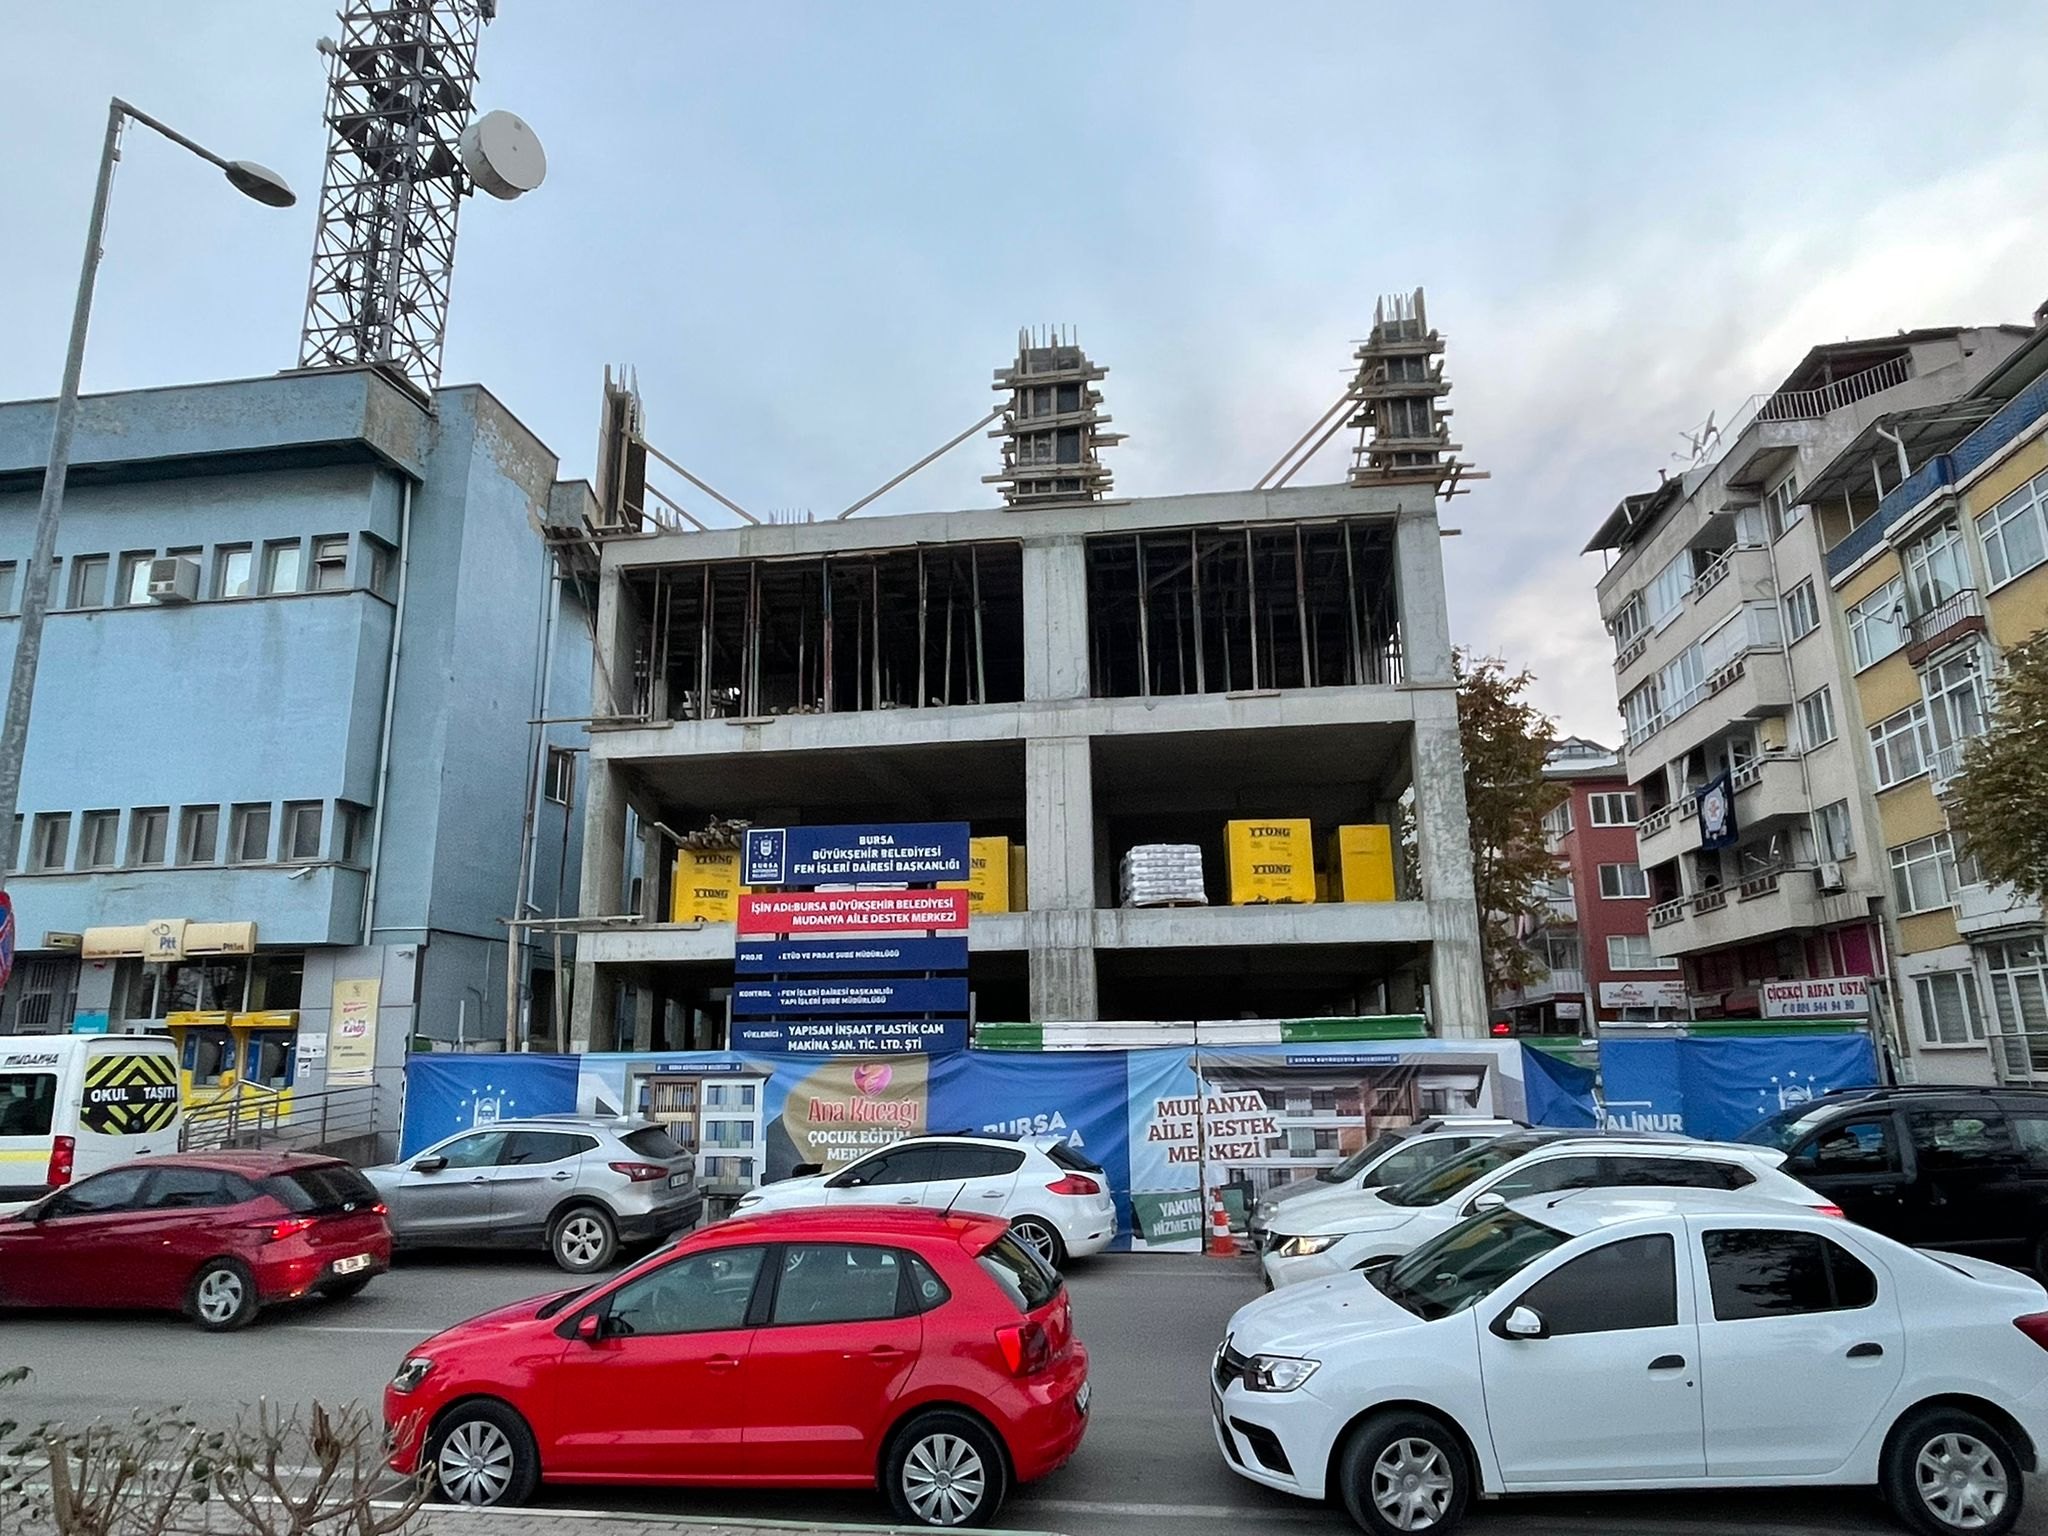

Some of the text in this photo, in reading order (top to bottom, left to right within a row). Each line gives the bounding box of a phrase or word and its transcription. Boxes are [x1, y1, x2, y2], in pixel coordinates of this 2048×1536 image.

[1249, 827, 1291, 837] YTONG
[859, 835, 894, 845] BURSA
[812, 845, 941, 860] BÜYÜKŞEHİR BELEDİYESİ
[794, 864, 815, 874] FEN
[817, 861, 850, 874] İŞLERİ
[852, 860, 894, 872] DAİRESİ
[896, 859, 960, 873] BAŞKANLIĞI
[751, 901, 771, 915] İŞİN
[829, 899, 894, 912] BÜYÜKŞEHİR
[896, 898, 953, 910] BELEDİYESİ
[792, 911, 957, 926] MUDANYA AİLE DESTEK MERKEZİ
[160, 936, 177, 950] Ptt
[740, 953, 763, 961] PROJE
[1839, 981, 1867, 996] USTA
[788, 1021, 944, 1037] YAPISAN İNŞAAT PLASTİK CAM
[788, 1037, 922, 1051] MAKİNA SAN. TİC. LTD. ŞTİ
[91, 1086, 176, 1102] OKUL TAŞITI
[808, 1097, 919, 1129] Ana Kucağı
[1148, 1119, 1194, 1141] AİLE
[808, 1130, 860, 1147] ÇOCUK
